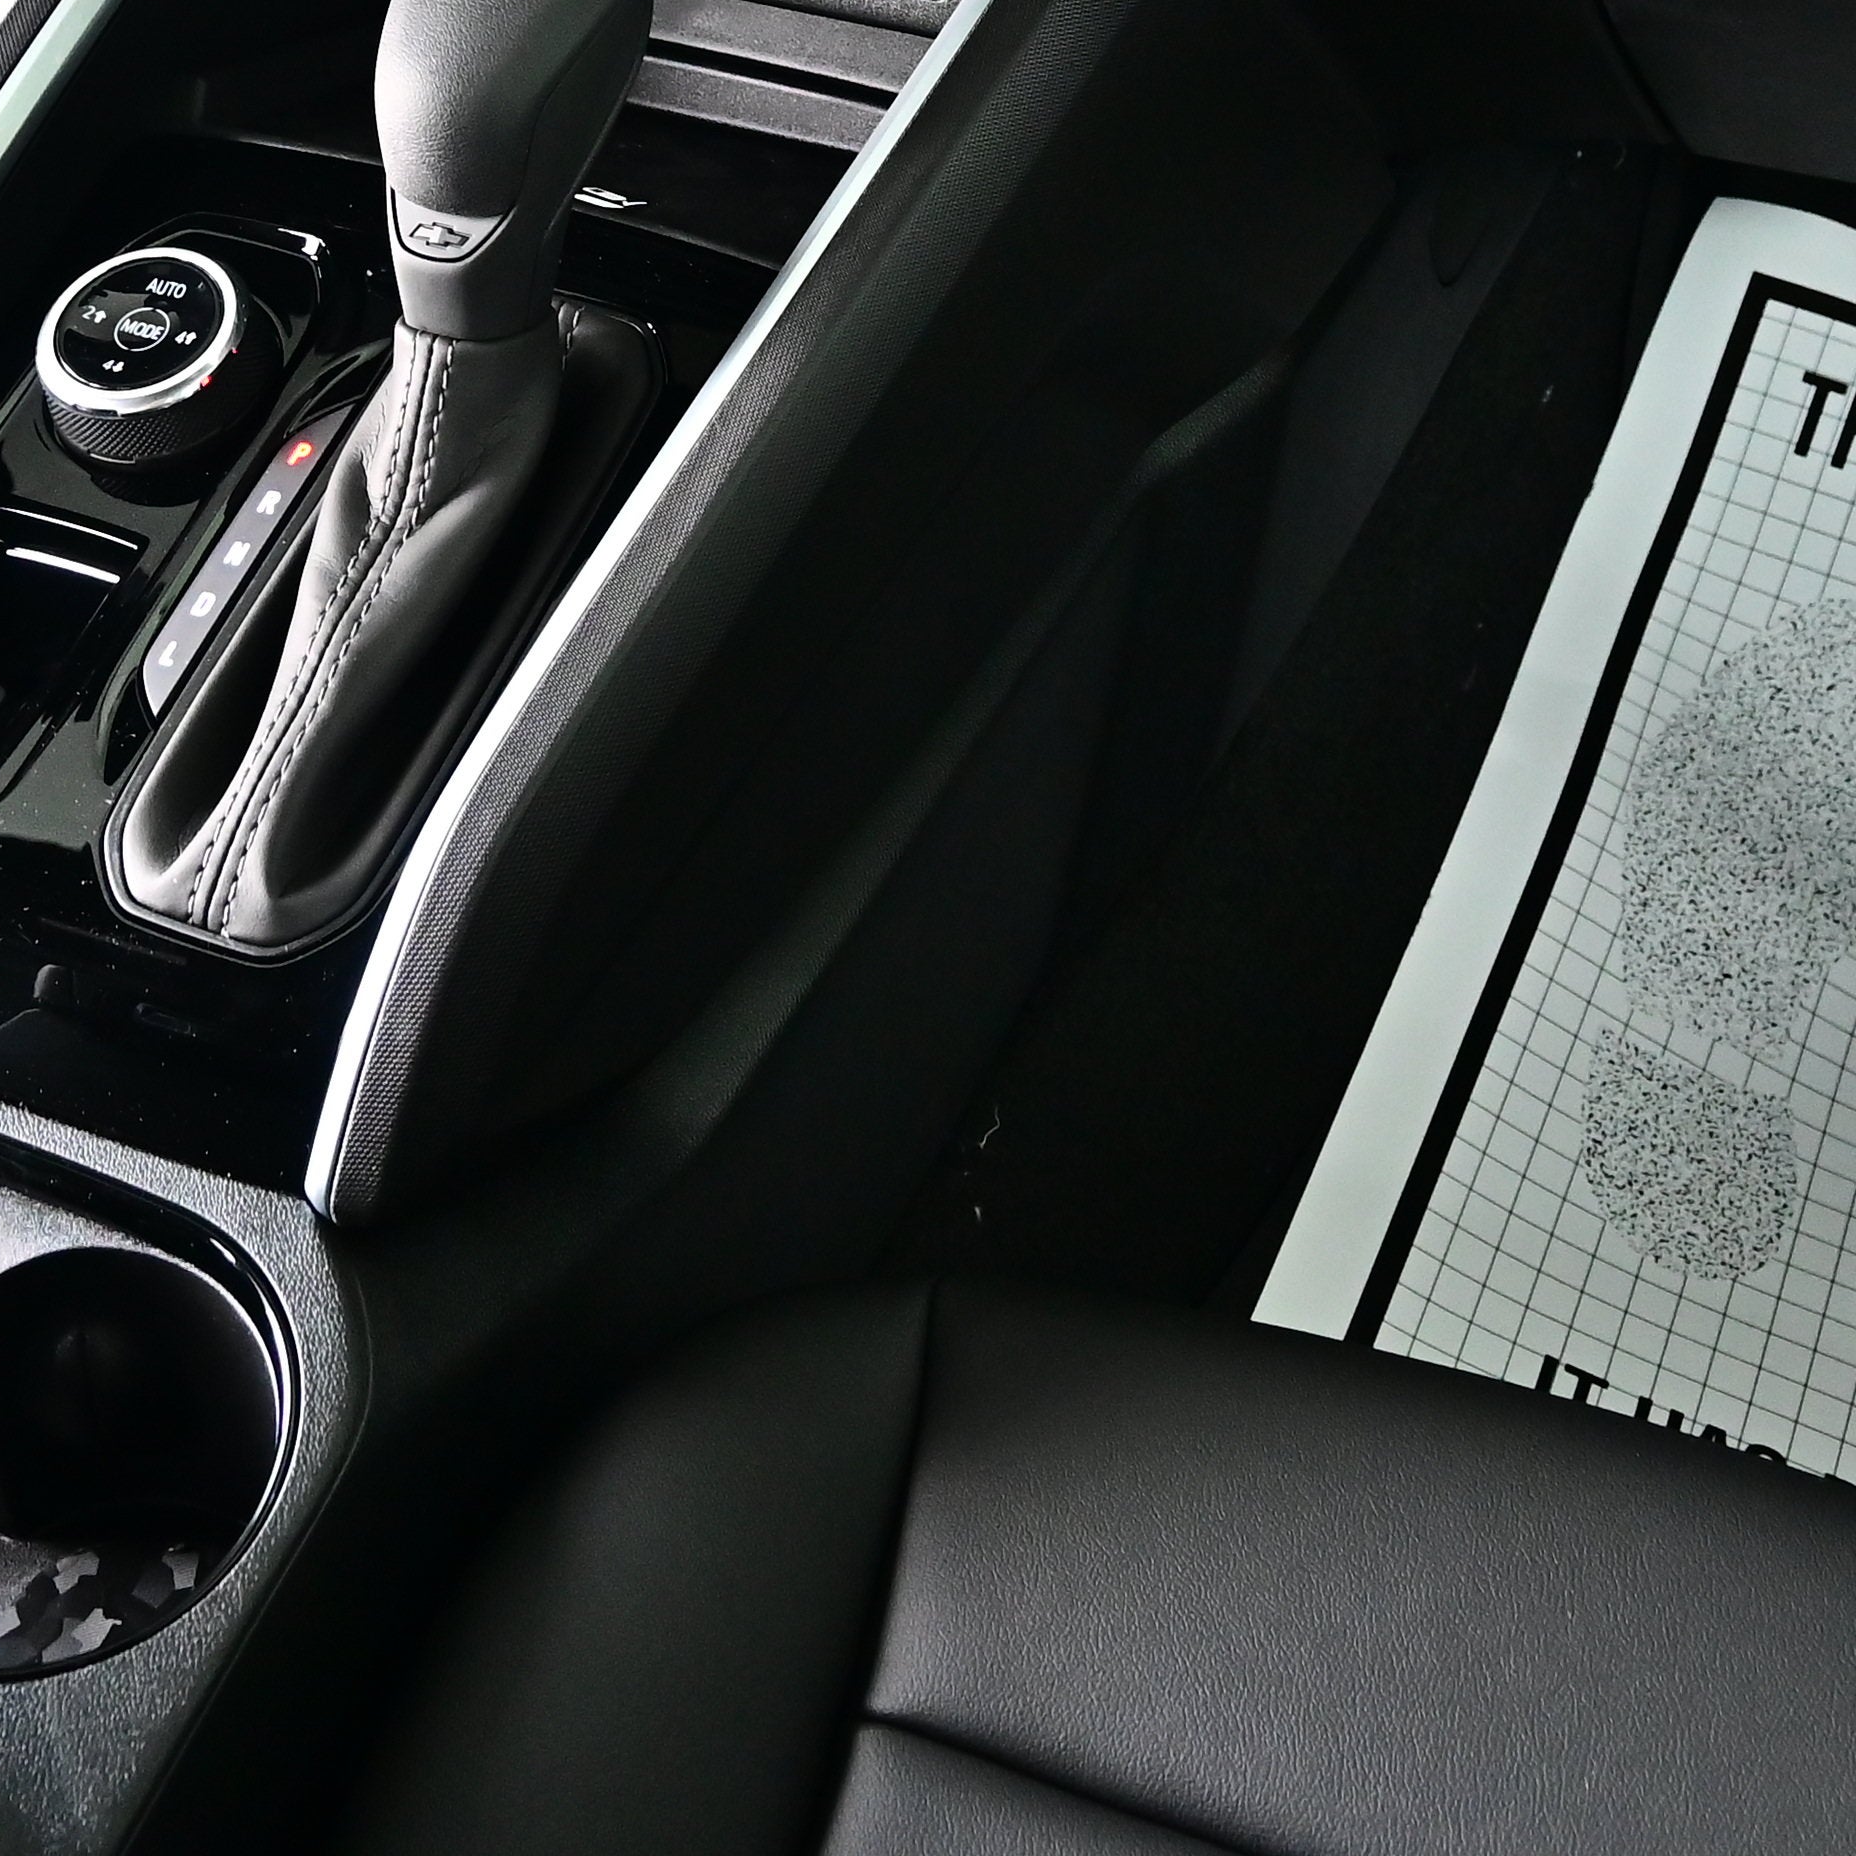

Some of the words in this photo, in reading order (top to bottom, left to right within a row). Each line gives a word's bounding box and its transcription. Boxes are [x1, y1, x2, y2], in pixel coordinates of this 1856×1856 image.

[145, 278, 187, 299] AUTO
[119, 318, 165, 341] MODE
[287, 441, 313, 466] P
[256, 490, 282, 515] R
[223, 541, 251, 567] N
[189, 591, 217, 618] D
[158, 640, 178, 667] L
